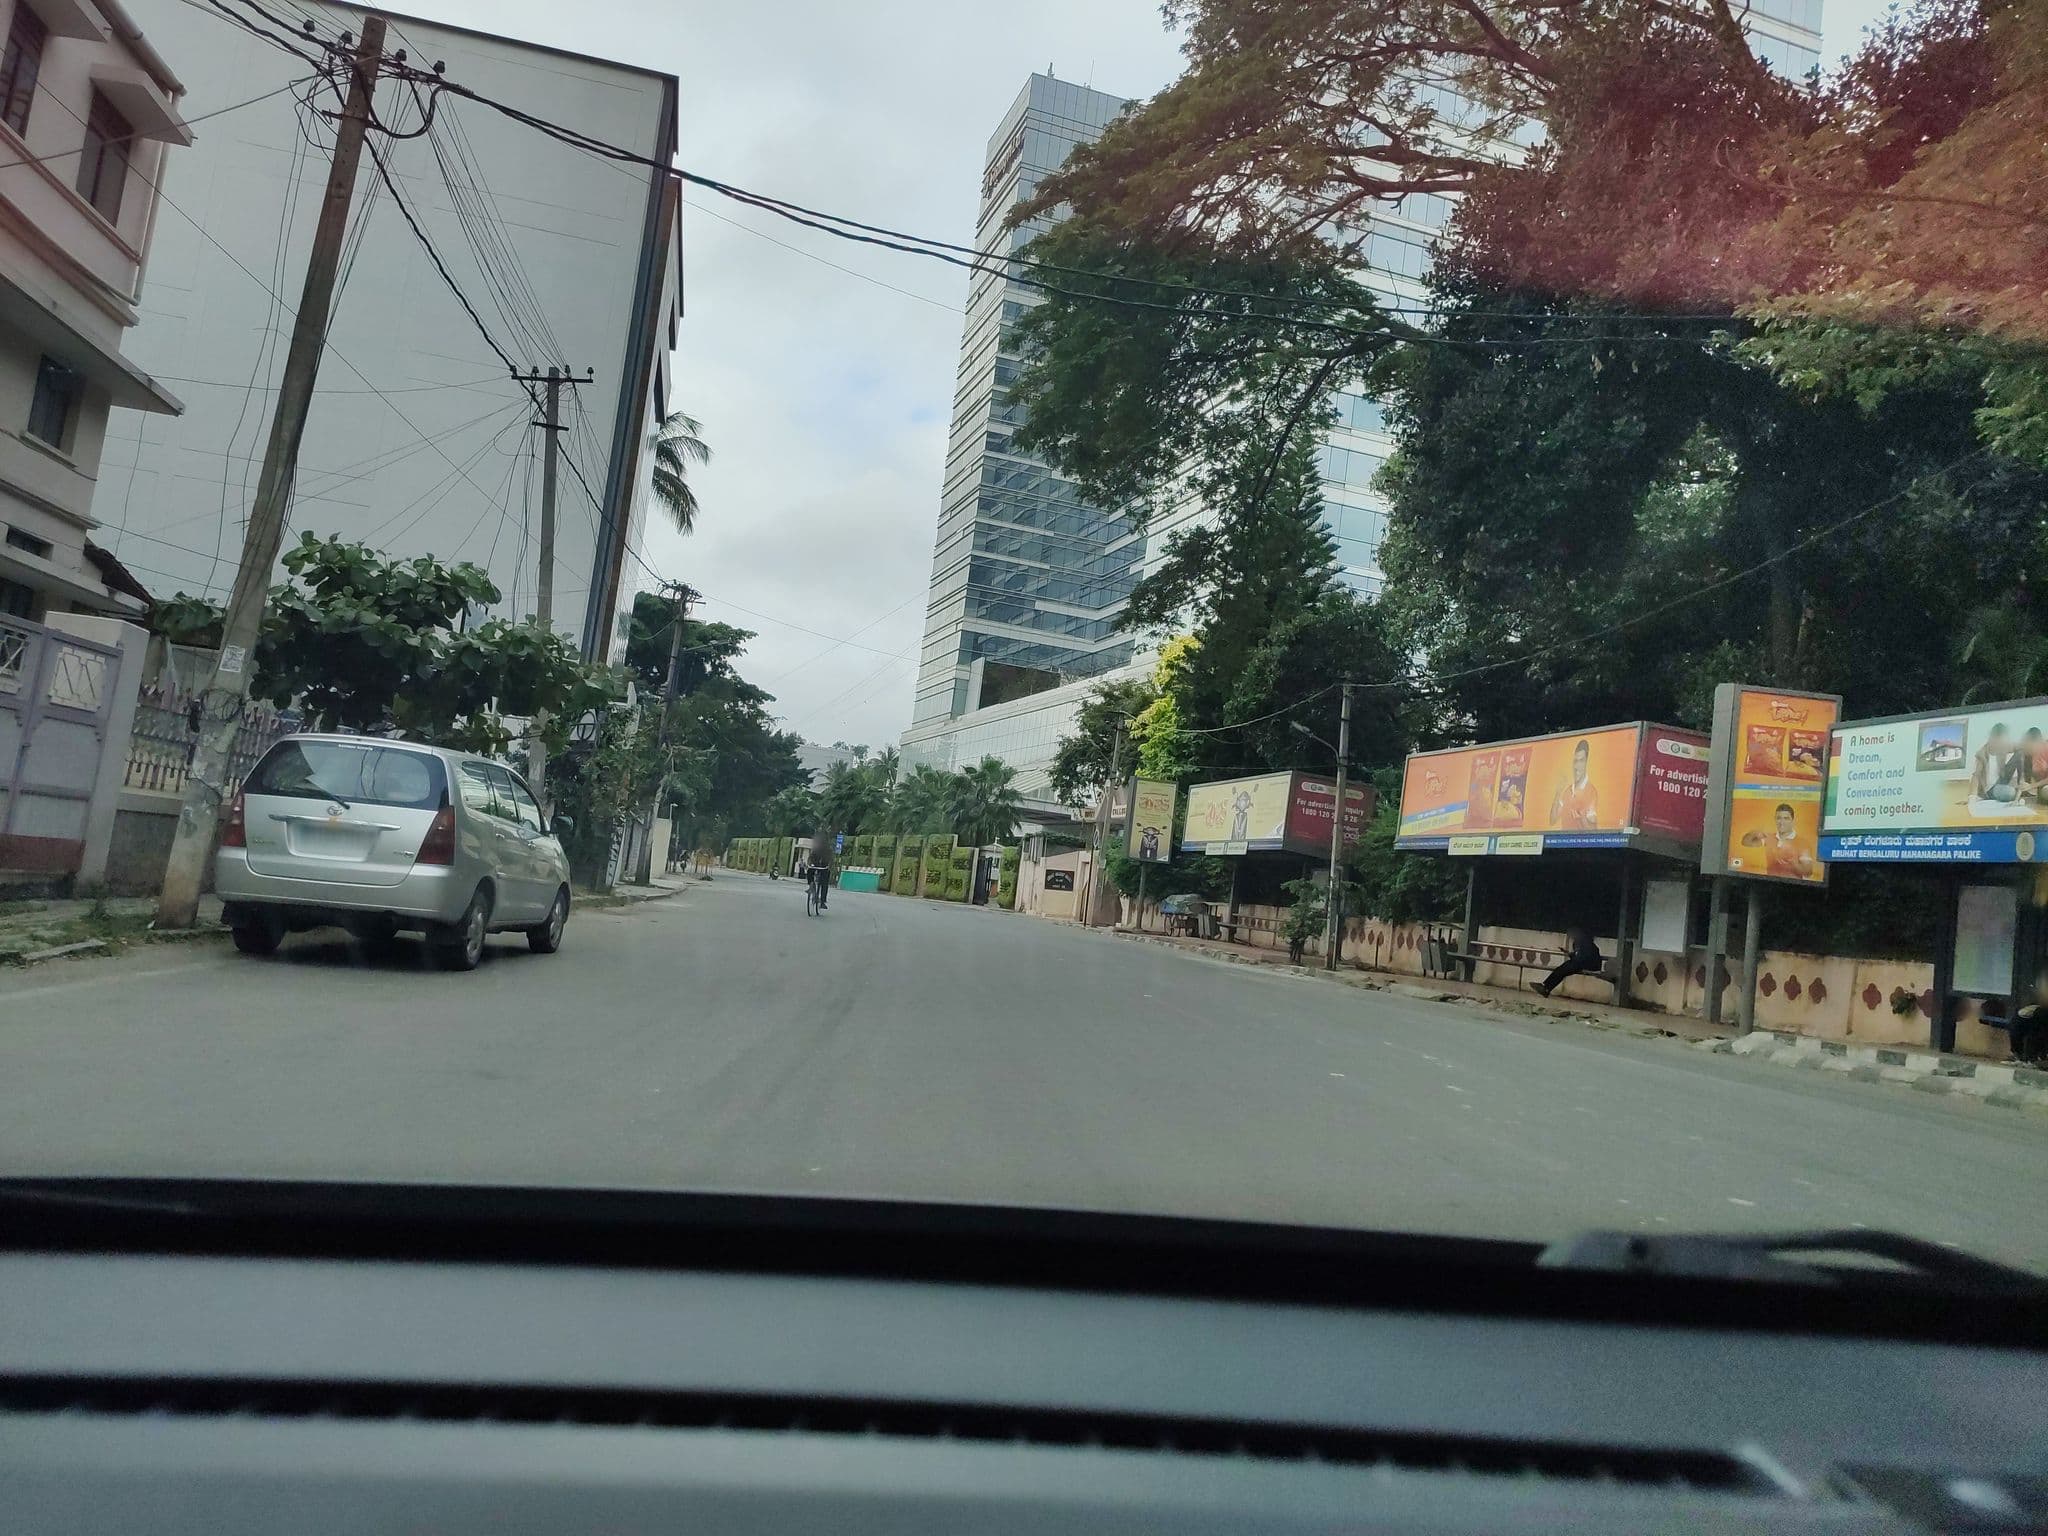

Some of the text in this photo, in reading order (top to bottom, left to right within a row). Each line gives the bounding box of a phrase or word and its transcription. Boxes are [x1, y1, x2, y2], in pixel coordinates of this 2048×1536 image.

[1850, 732, 1895, 746] A home is
[1849, 753, 1882, 765] Dream,
[1649, 765, 1665, 776] For
[1848, 767, 1905, 781] Comfort and
[1657, 781, 1681, 794] 1800
[1683, 786, 1700, 798] 120
[1846, 786, 1903, 799] Convenience
[1296, 798, 1307, 806] For
[1844, 803, 1924, 819] coming together.
[1831, 849, 1981, 859] BRUHAT BENGALURU MAHANAGARA PALIKE
